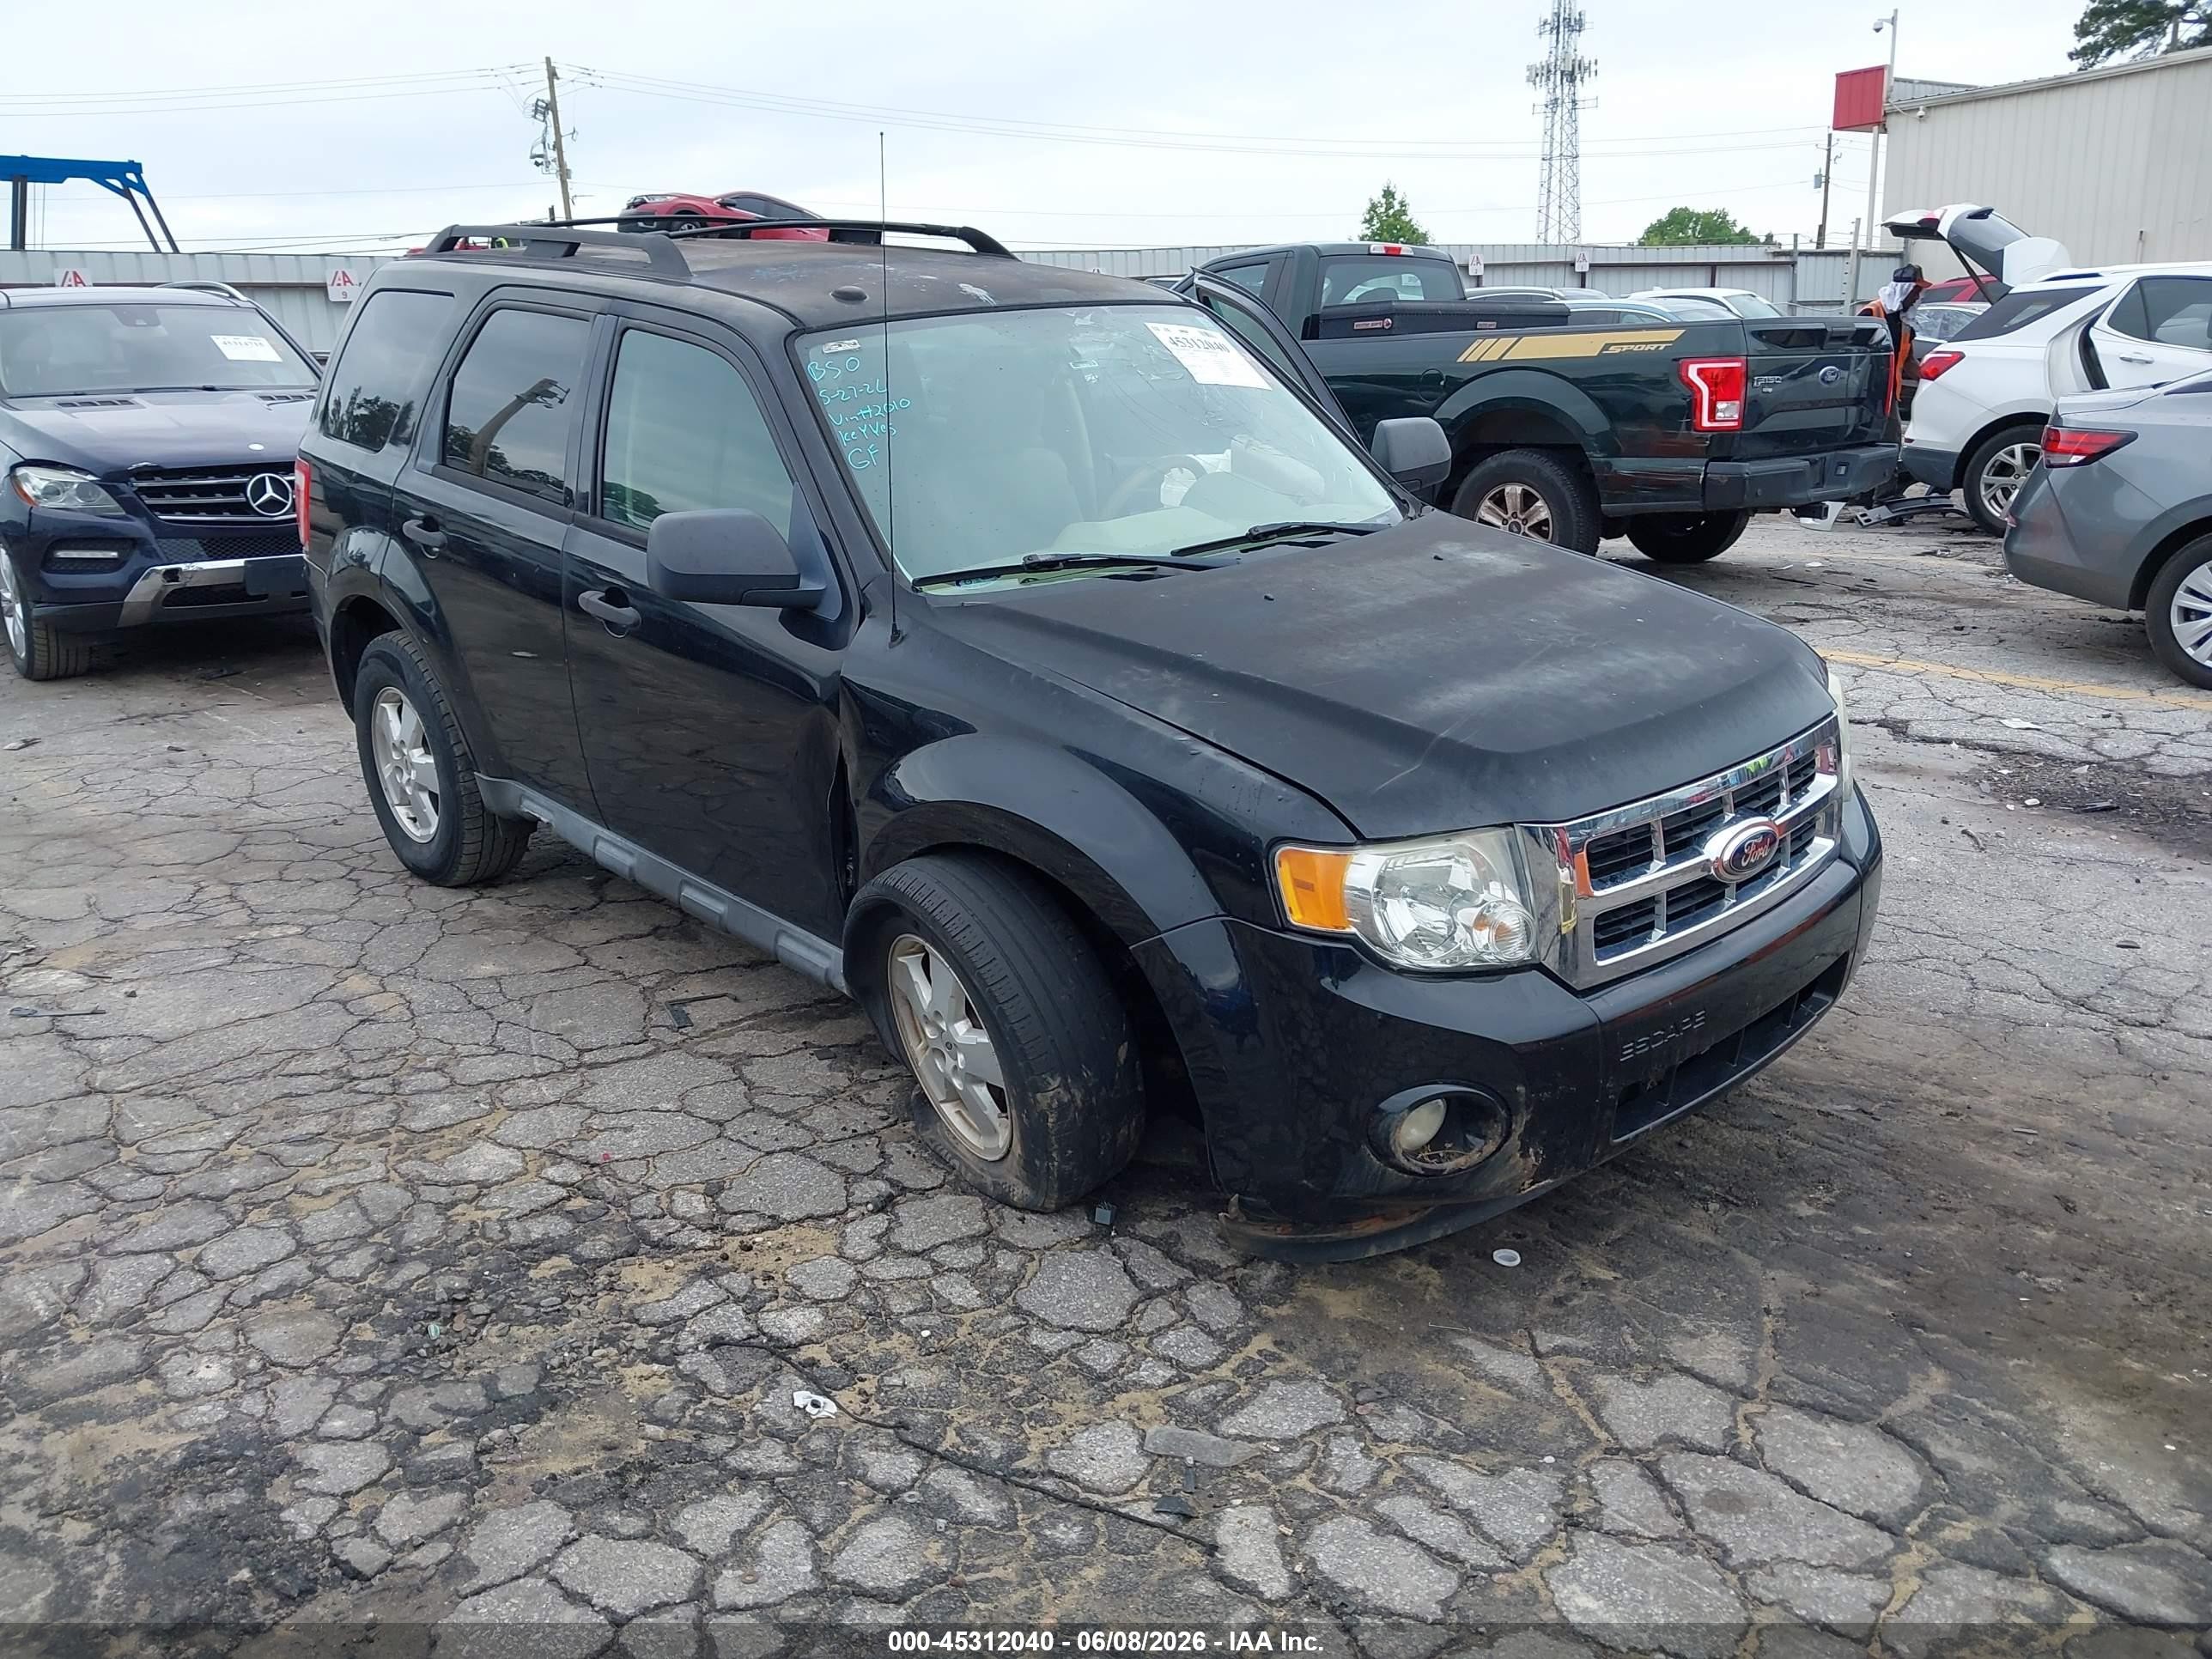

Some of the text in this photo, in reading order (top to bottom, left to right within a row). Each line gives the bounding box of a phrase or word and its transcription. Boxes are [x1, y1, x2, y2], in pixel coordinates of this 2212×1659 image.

[1168, 336, 1231, 354] 45312040
[1601, 343, 1674, 354] SPORT
[1741, 835, 1771, 867] Ford
[1619, 1010, 1706, 1062] ESCAPE
